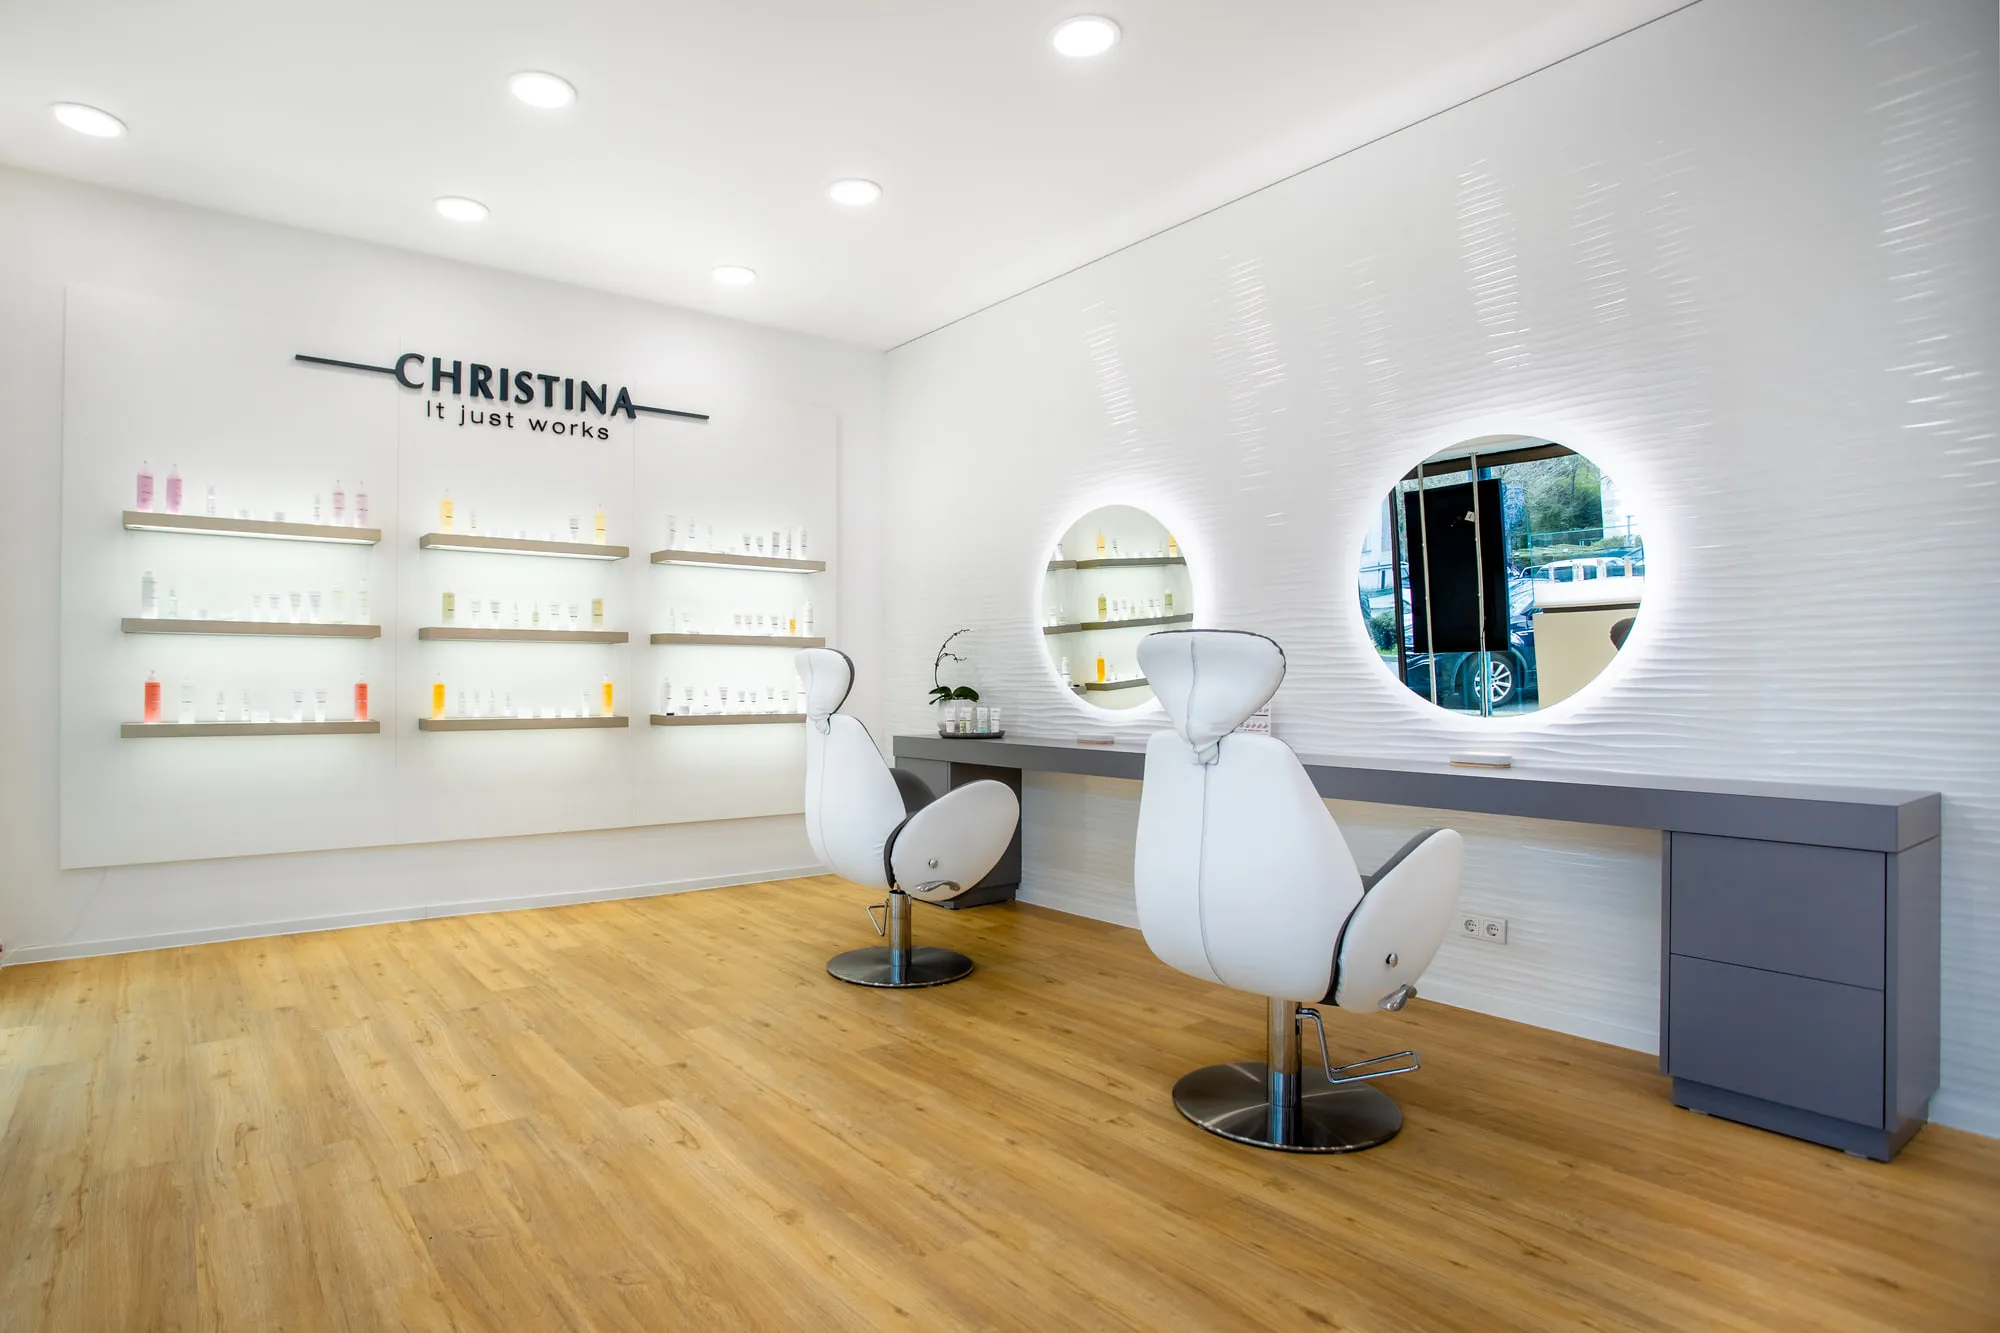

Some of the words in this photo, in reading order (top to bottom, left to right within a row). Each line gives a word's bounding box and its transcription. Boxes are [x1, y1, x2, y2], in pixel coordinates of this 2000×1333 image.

[395, 352, 637, 419] CHRISTINA
[427, 400, 445, 419] It
[458, 404, 514, 429] just
[528, 418, 609, 440] works
